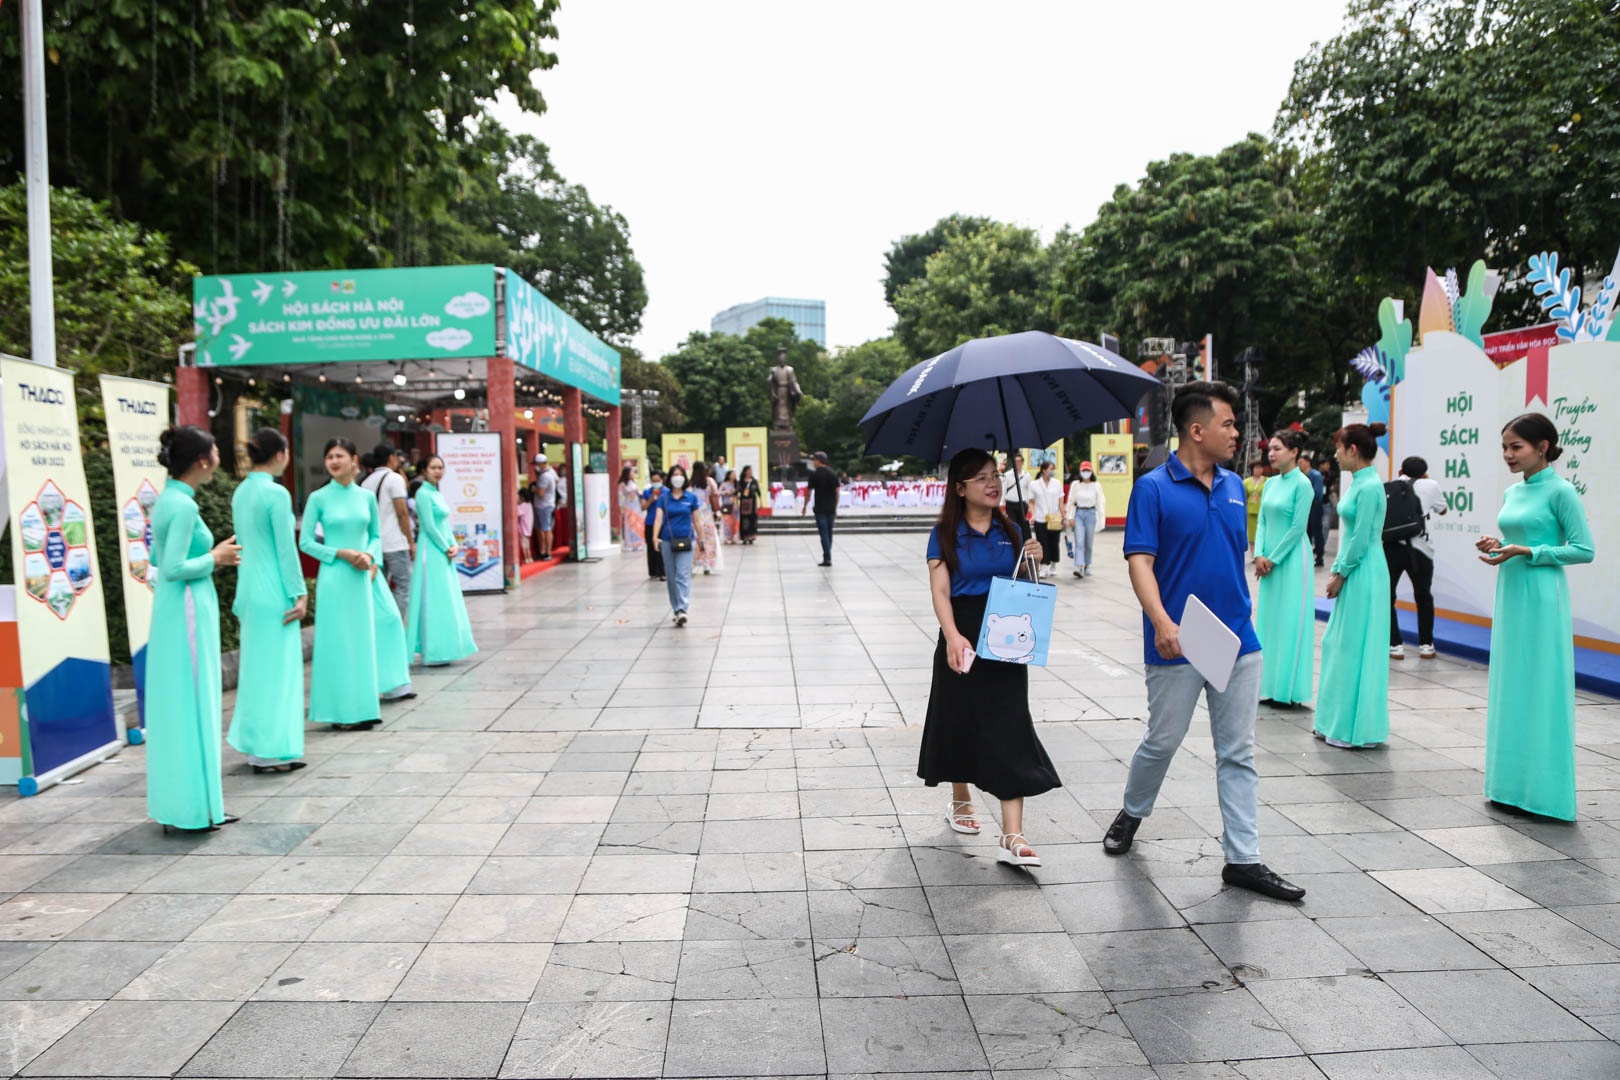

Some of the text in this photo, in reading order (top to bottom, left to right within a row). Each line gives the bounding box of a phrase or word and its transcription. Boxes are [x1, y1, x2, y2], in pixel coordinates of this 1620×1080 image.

[283, 297, 404, 317] HỘI SÁCH HÀ NỘI
[248, 319, 285, 334] SÁCH
[288, 320, 313, 332] KIM
[316, 315, 356, 331] ĐỒNG
[411, 313, 440, 328] LỚN
[1446, 390, 1473, 417] HỘI
[1553, 396, 1598, 425] Truyền
[1440, 424, 1479, 446] SÁCH
[1558, 428, 1592, 454] thống
[1445, 452, 1471, 479] HÀ
[1442, 486, 1474, 518] NỘI
